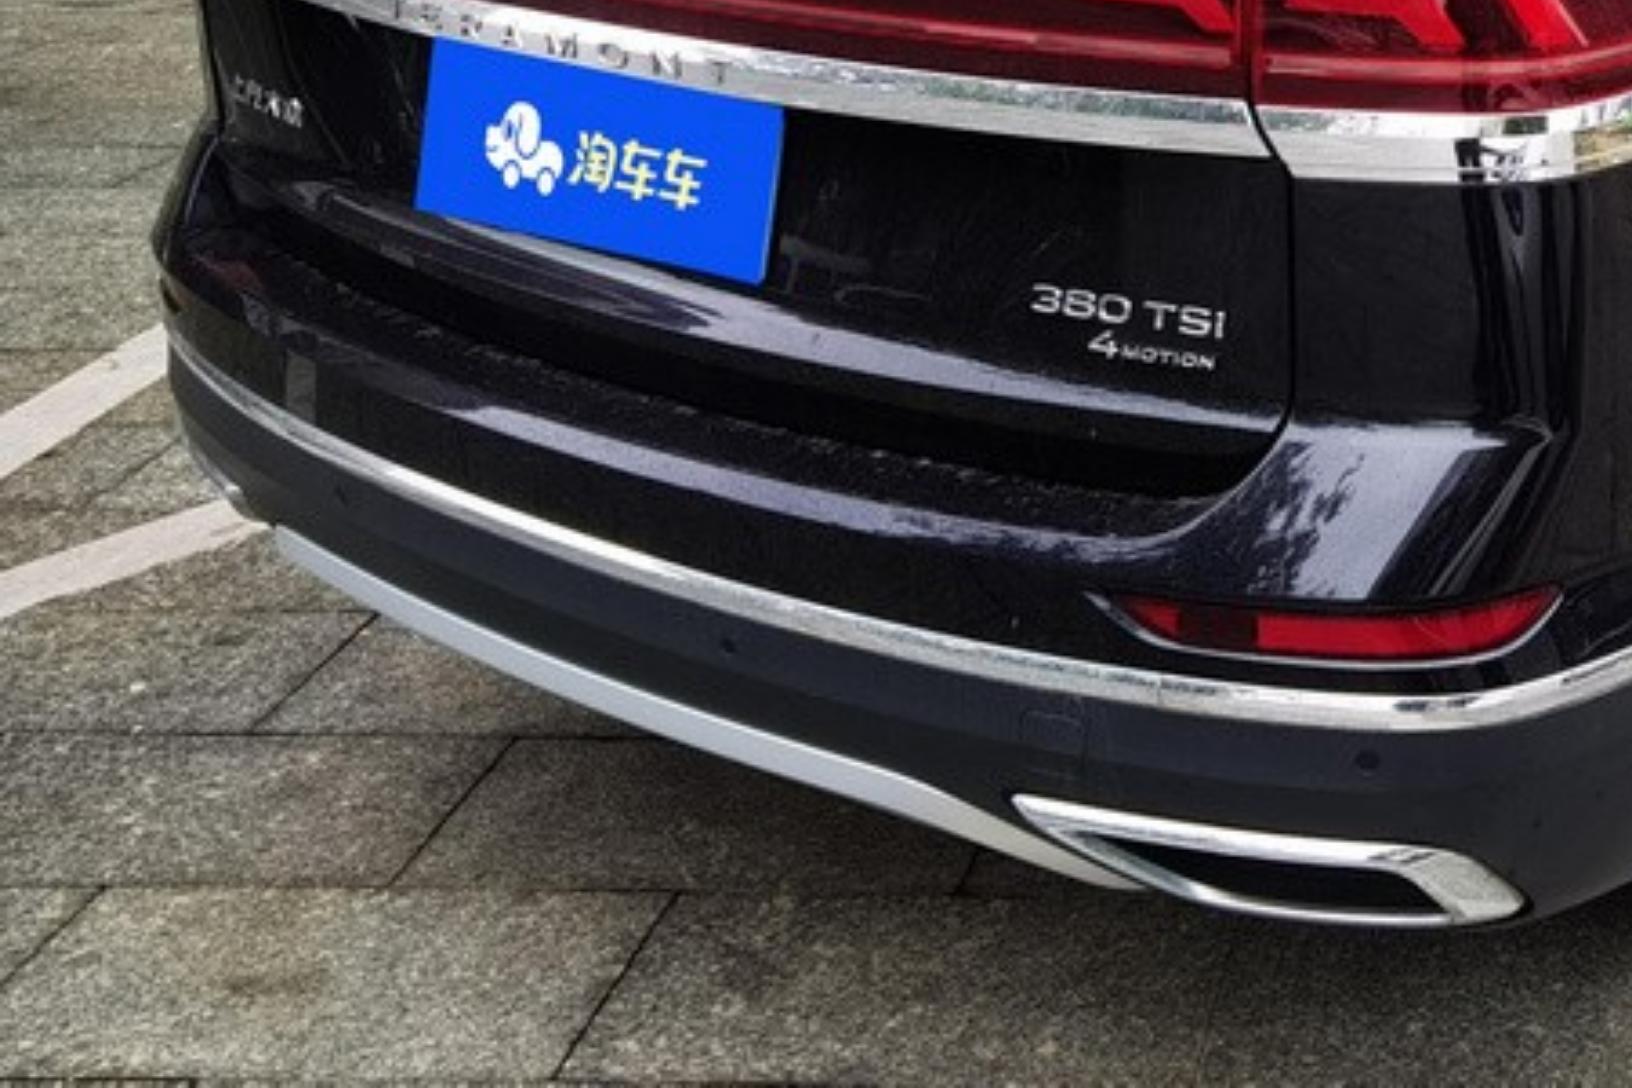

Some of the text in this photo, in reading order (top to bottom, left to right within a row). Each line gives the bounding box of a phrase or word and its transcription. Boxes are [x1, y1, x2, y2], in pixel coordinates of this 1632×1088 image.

[1030, 282, 1227, 340] 380 TSI
[1088, 329, 1215, 372] 4MOTION
